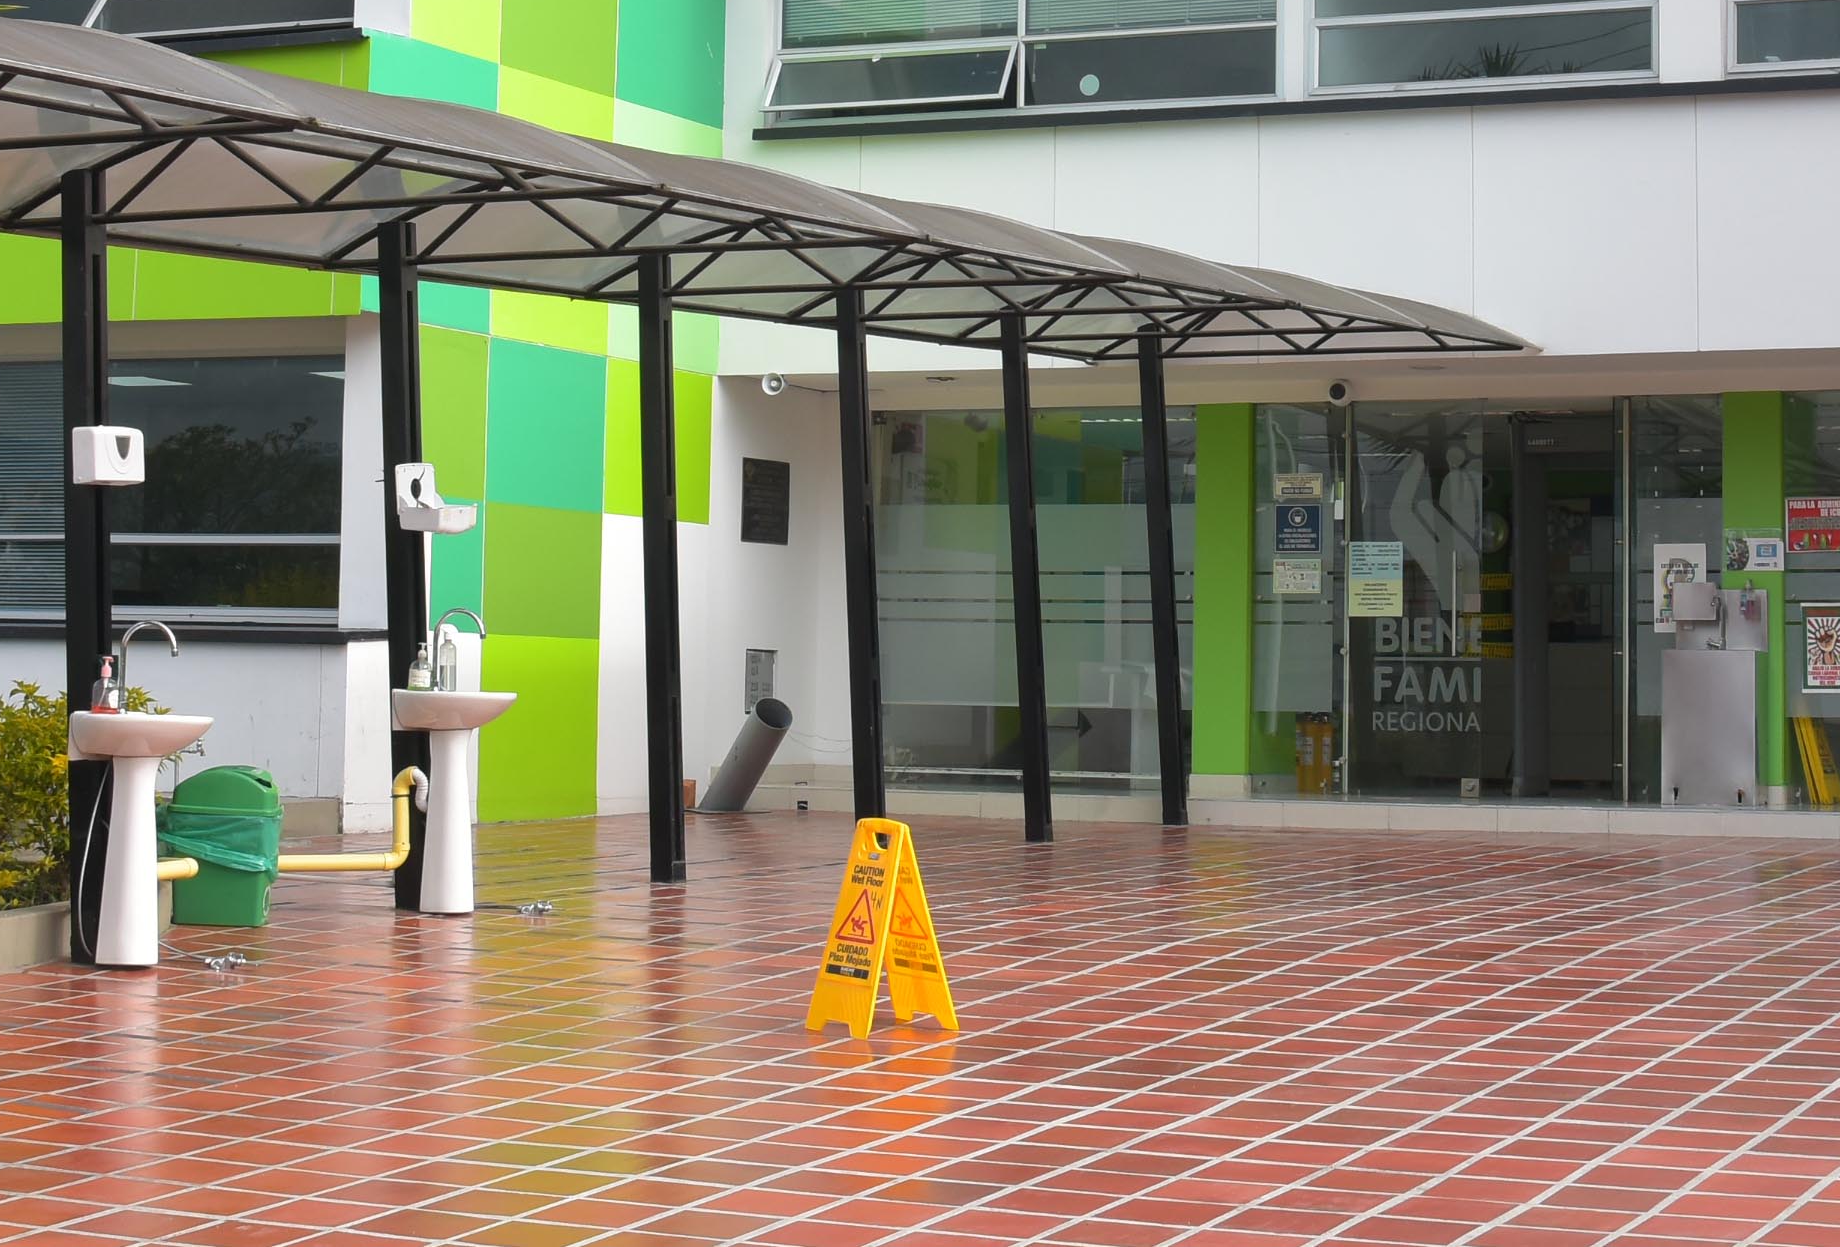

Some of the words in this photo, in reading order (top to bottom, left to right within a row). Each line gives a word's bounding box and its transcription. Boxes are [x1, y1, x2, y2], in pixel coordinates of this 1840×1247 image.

[1807, 500, 1815, 509] LA
[854, 865, 885, 878] CAUTION
[851, 874, 865, 884] Wet
[866, 876, 884, 887] Floor
[837, 943, 868, 955] CUIDADO
[829, 952, 844, 962] Piso
[845, 954, 871, 967] Mojado
